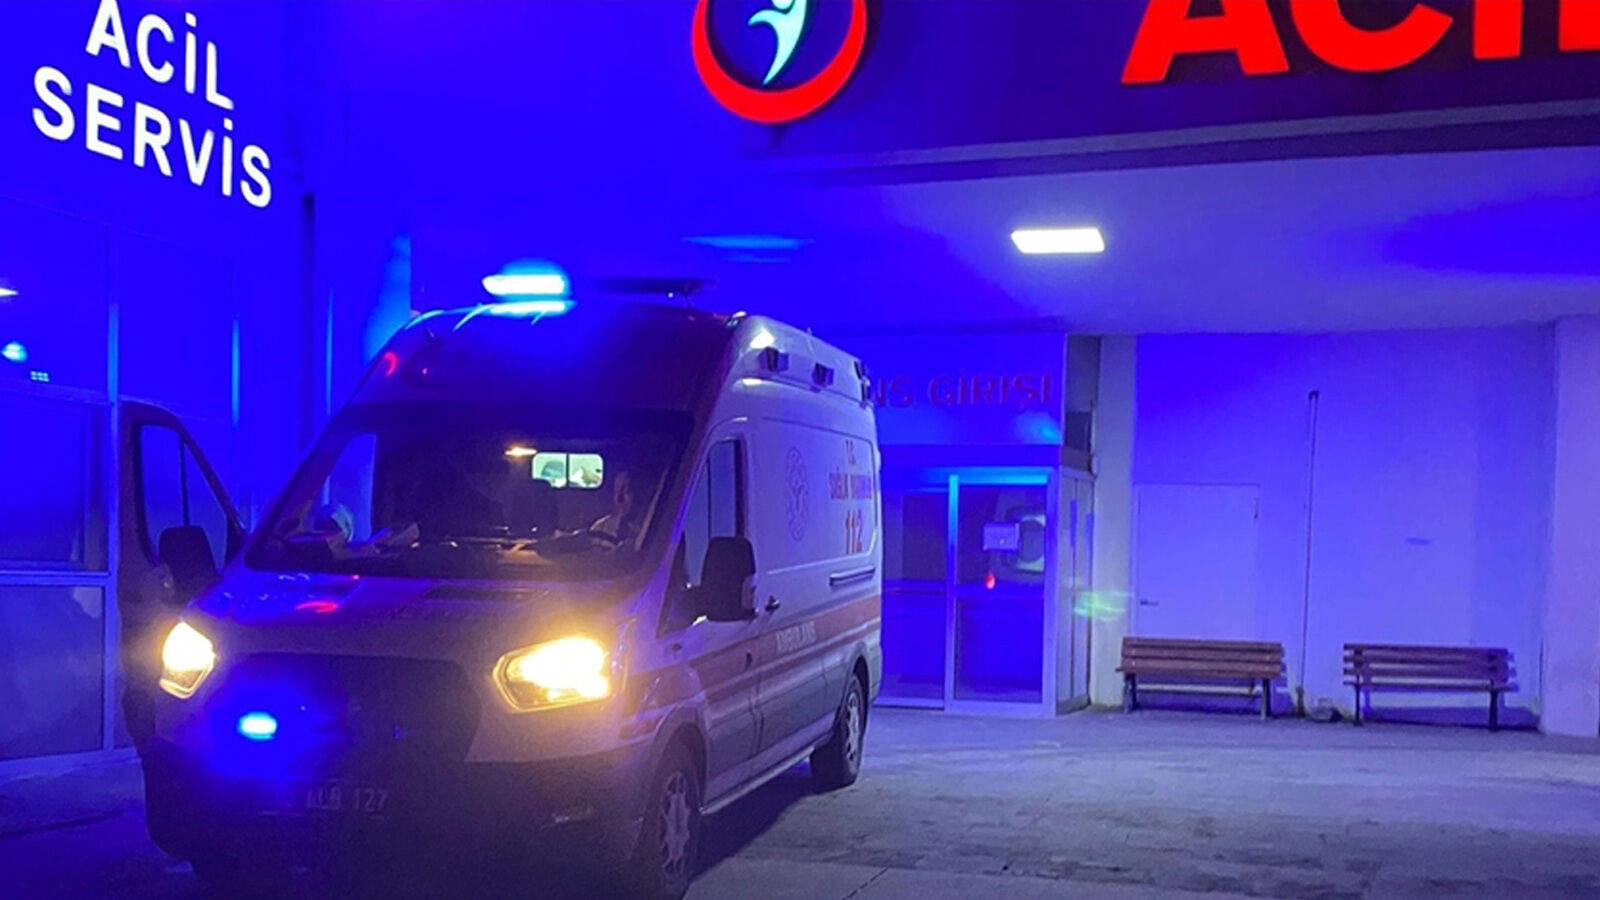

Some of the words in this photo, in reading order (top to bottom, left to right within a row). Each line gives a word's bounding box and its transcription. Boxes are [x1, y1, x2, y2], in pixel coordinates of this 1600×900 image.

[85, 0, 234, 110] ACİL
[32, 65, 272, 208] SERVİS
[845, 509, 862, 555] 112
